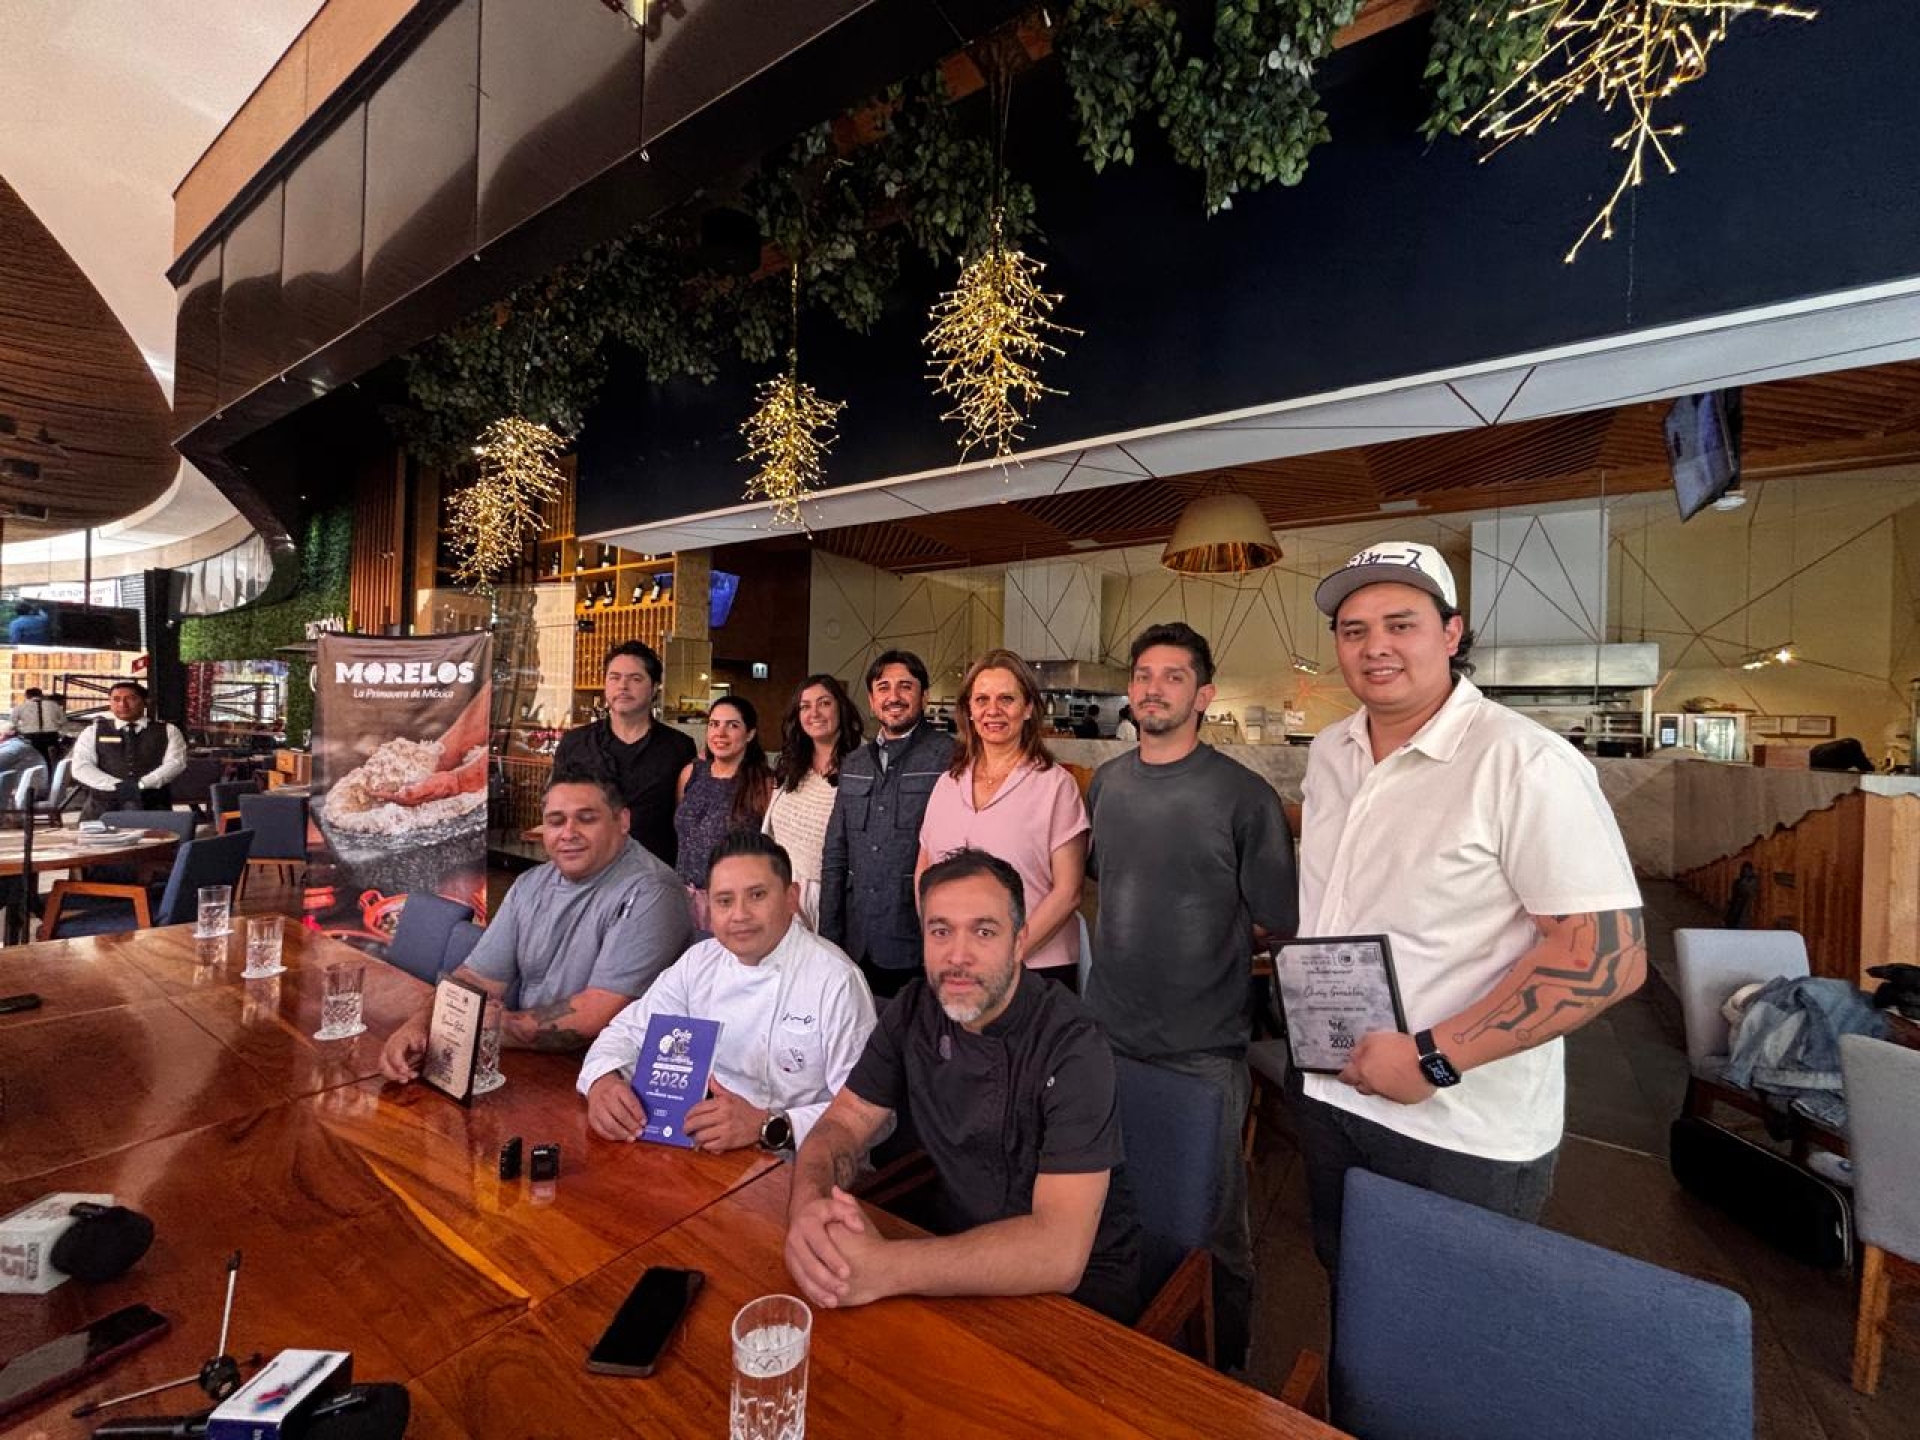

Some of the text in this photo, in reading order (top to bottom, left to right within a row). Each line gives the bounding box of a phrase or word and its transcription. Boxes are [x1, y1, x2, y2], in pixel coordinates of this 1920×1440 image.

[335, 661, 475, 684] MORELOS
[353, 687, 455, 699] La Primavera de México
[649, 1070, 689, 1090] 2026
